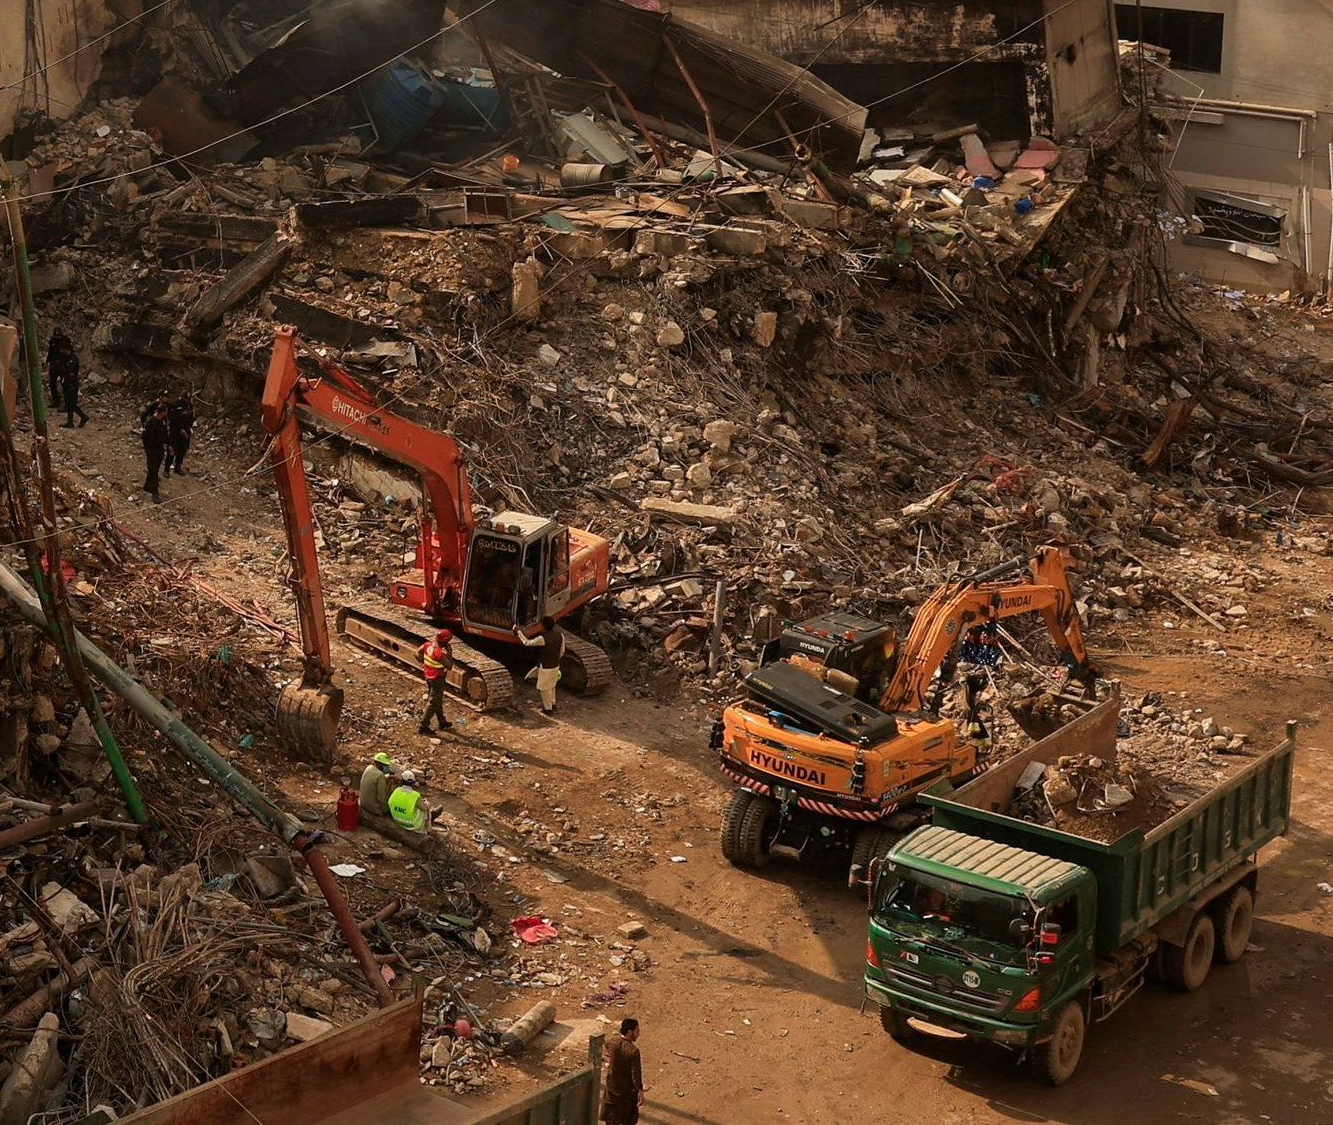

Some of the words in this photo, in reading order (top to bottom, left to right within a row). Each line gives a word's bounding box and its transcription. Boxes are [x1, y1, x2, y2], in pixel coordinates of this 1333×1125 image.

[337, 400, 367, 425] HITACHI
[996, 595, 1032, 610] YUNDAI
[750, 749, 826, 785] HYUNDAI
